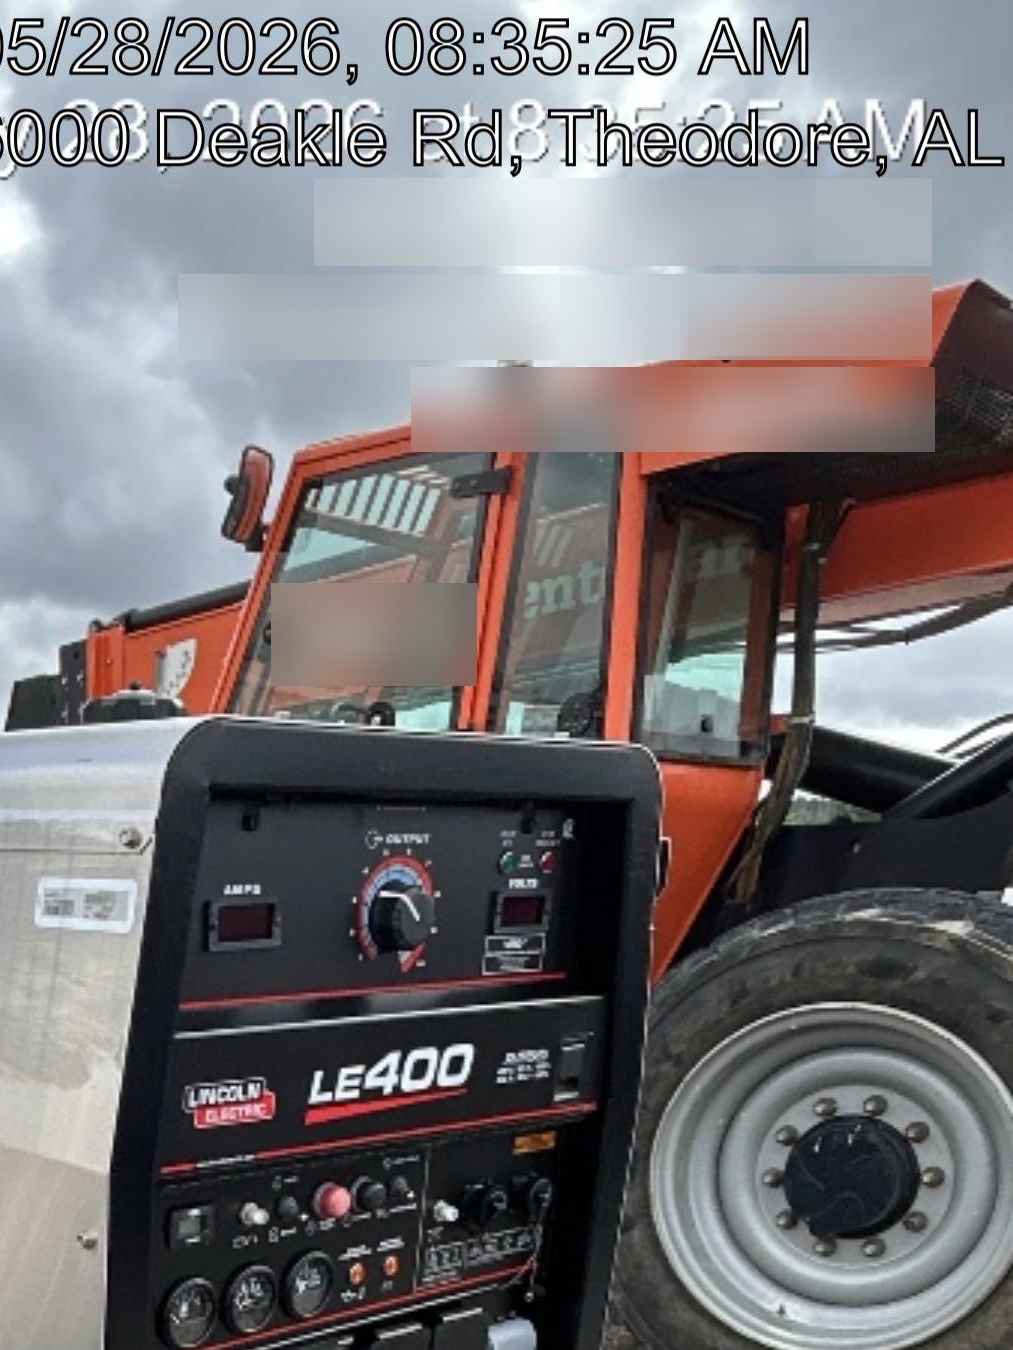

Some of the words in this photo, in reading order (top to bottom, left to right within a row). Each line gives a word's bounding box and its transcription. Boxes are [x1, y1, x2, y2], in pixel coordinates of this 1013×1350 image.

[223, 884, 261, 896] AMPS
[308, 1044, 474, 1105] LE400
[188, 1082, 261, 1108] LINCOLN
[205, 1102, 268, 1123] ELECTRIC
